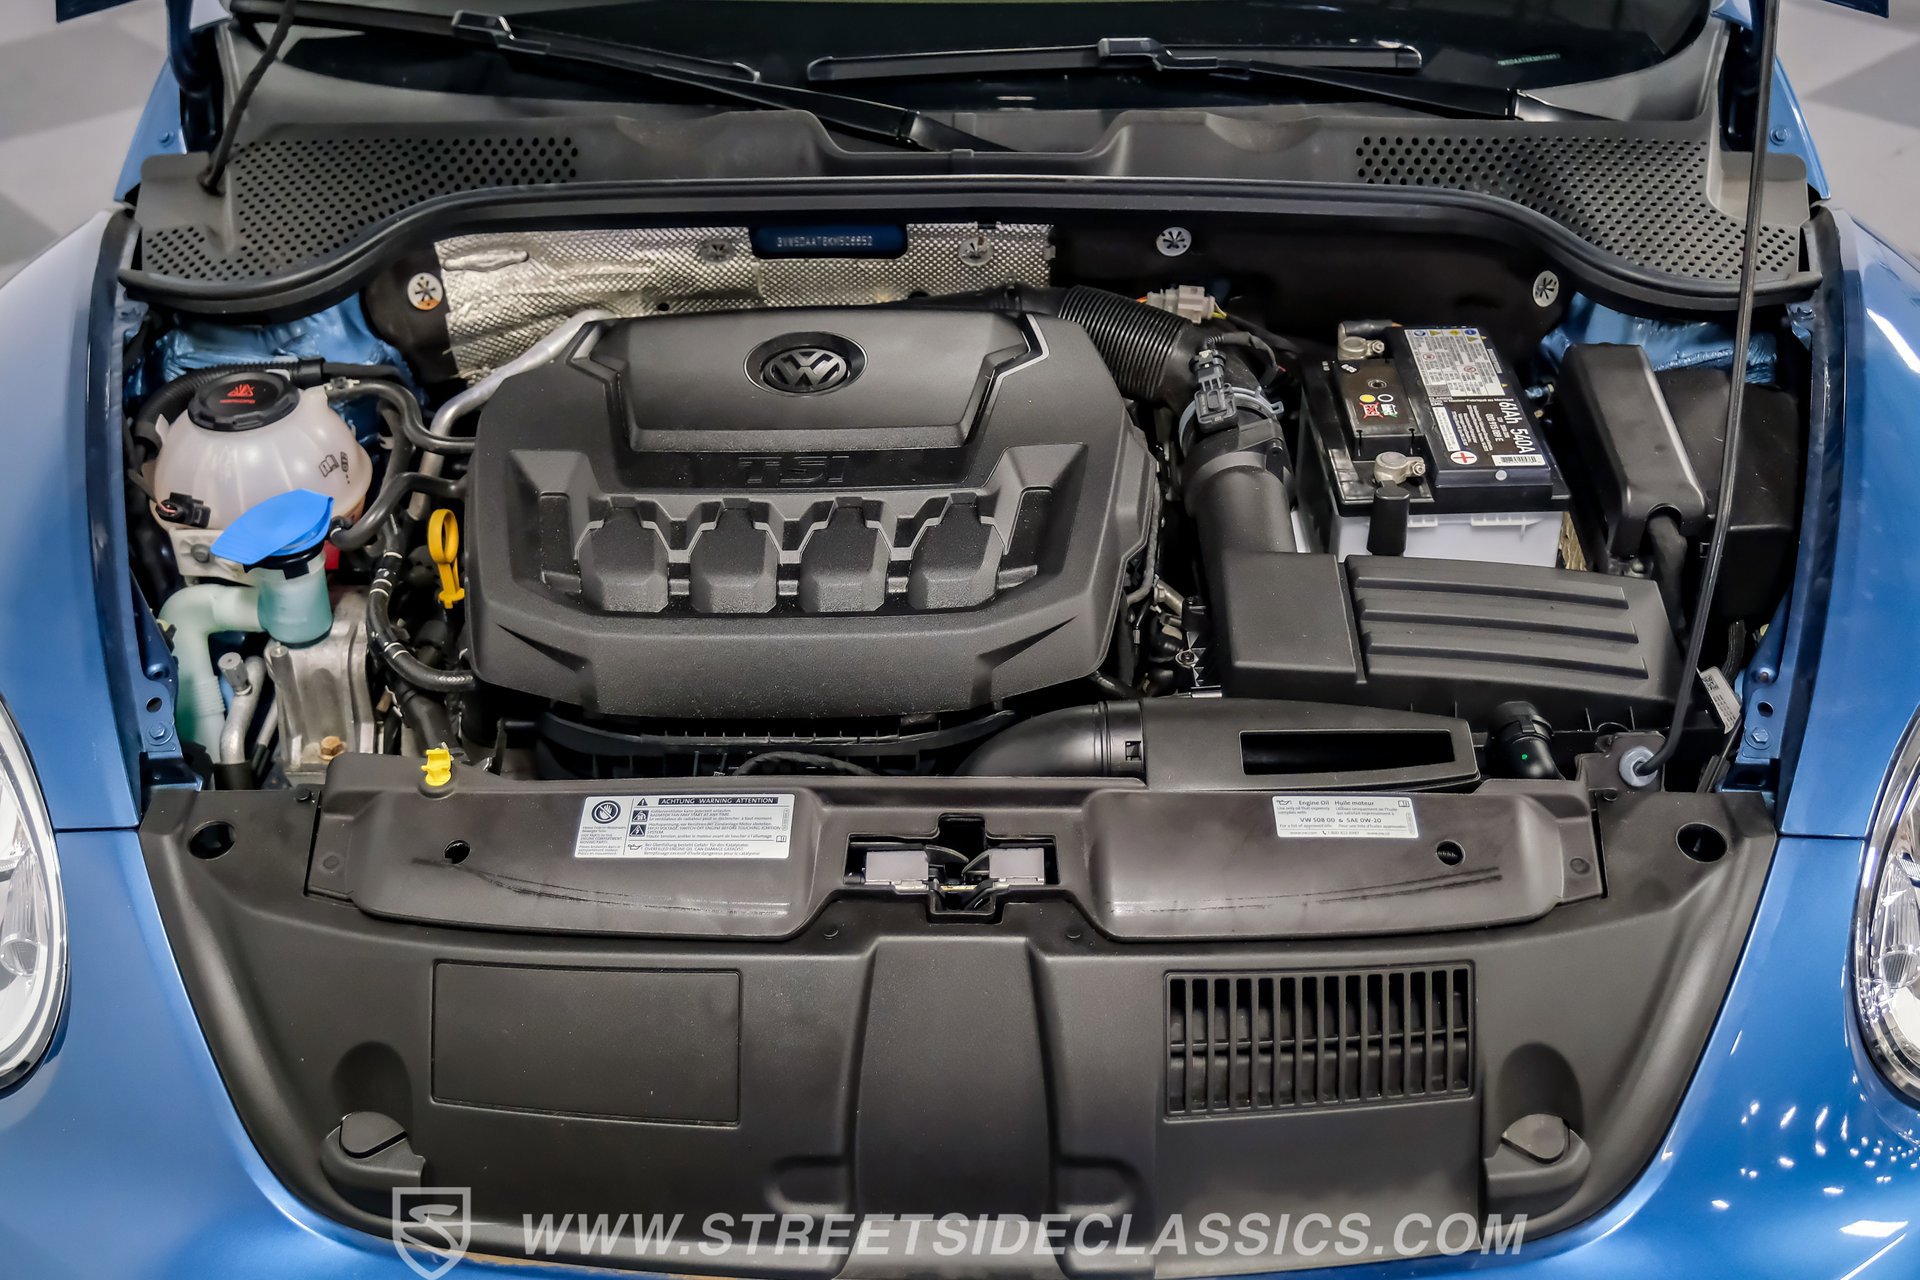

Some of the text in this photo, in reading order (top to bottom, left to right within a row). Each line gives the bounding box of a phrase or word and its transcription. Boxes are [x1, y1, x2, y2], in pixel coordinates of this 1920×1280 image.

[1498, 402, 1522, 424] 61Ah
[1510, 428, 1536, 454] 540A
[738, 456, 850, 483] TSI
